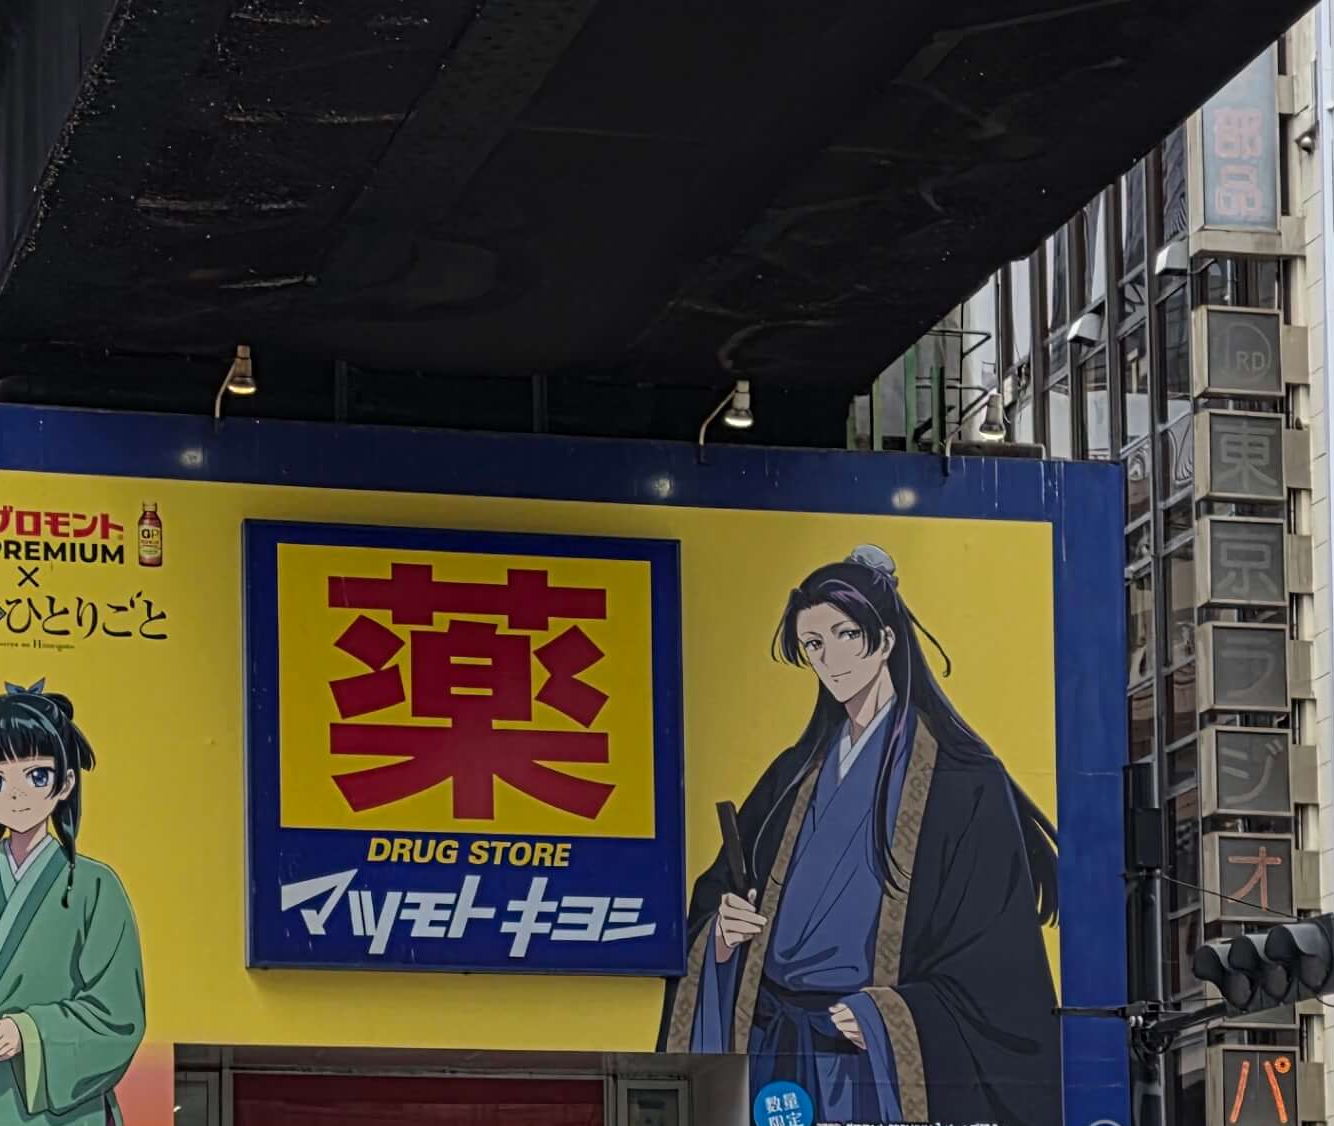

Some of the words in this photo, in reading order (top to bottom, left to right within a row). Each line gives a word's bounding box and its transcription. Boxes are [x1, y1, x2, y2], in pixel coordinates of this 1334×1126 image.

[327, 562, 616, 821] 薬
[366, 837, 458, 865] DRUG
[467, 840, 572, 868] STORE
[280, 867, 657, 958] マツモトキヨシ
[765, 1092, 799, 1113] 数量
